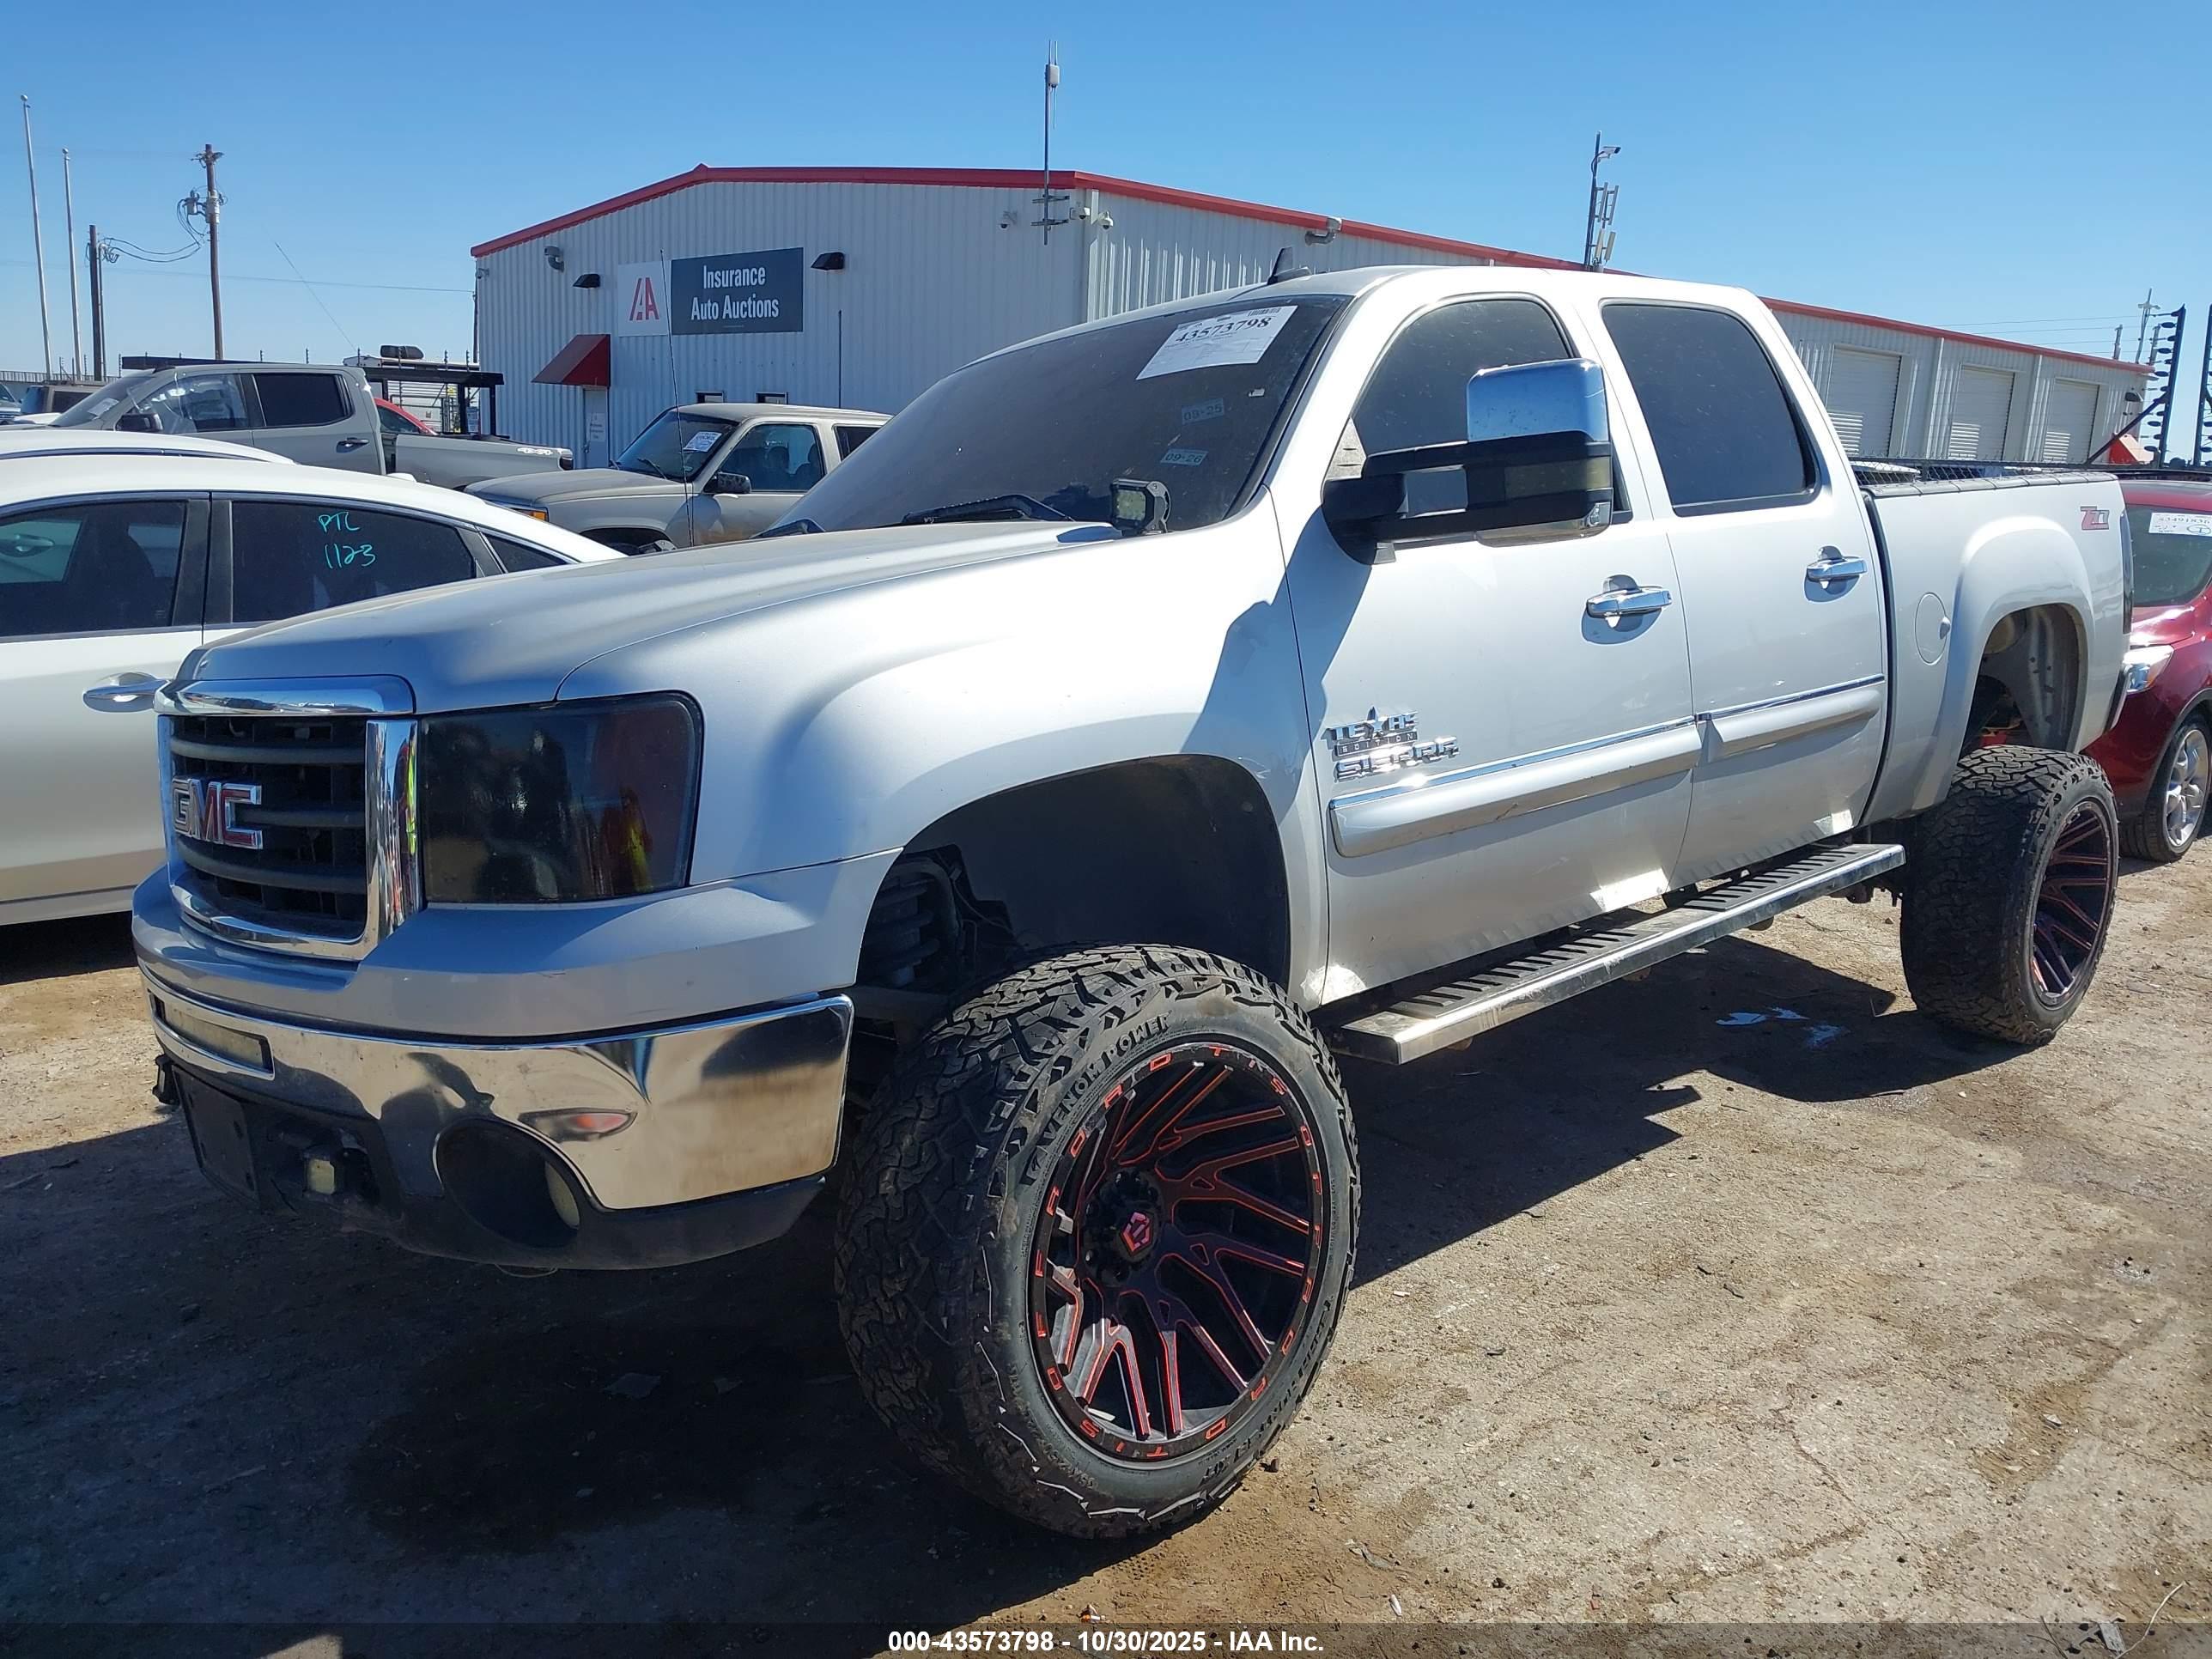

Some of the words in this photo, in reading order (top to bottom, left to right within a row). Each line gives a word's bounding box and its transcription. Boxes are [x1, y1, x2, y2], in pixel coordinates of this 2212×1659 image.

[703, 265, 766, 289] Insurance
[690, 297, 719, 321] Auto
[722, 294, 779, 319] Auctions
[1176, 317, 1271, 342] 43573798
[2080, 506, 2110, 530] Z71
[325, 543, 376, 568] 1123
[1334, 707, 1419, 741] TEXAS
[1341, 735, 1414, 754] EDITION
[172, 778, 264, 849] GMC
